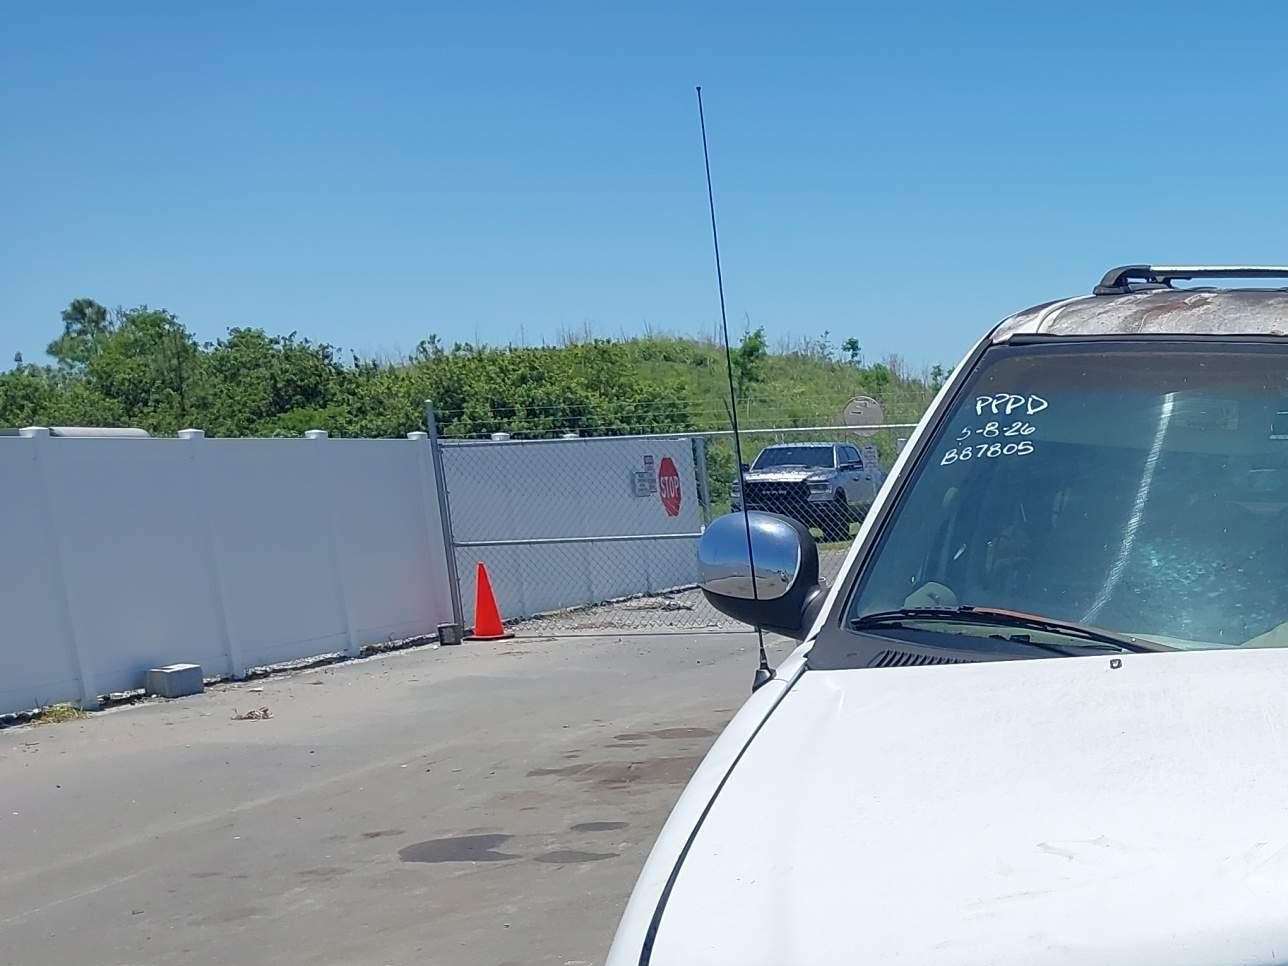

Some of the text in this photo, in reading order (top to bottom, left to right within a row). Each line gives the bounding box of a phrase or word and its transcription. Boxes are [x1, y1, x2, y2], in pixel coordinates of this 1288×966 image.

[976, 393, 1049, 416] PPPD
[940, 441, 1034, 466] B87805
[660, 475, 680, 499] STOP
